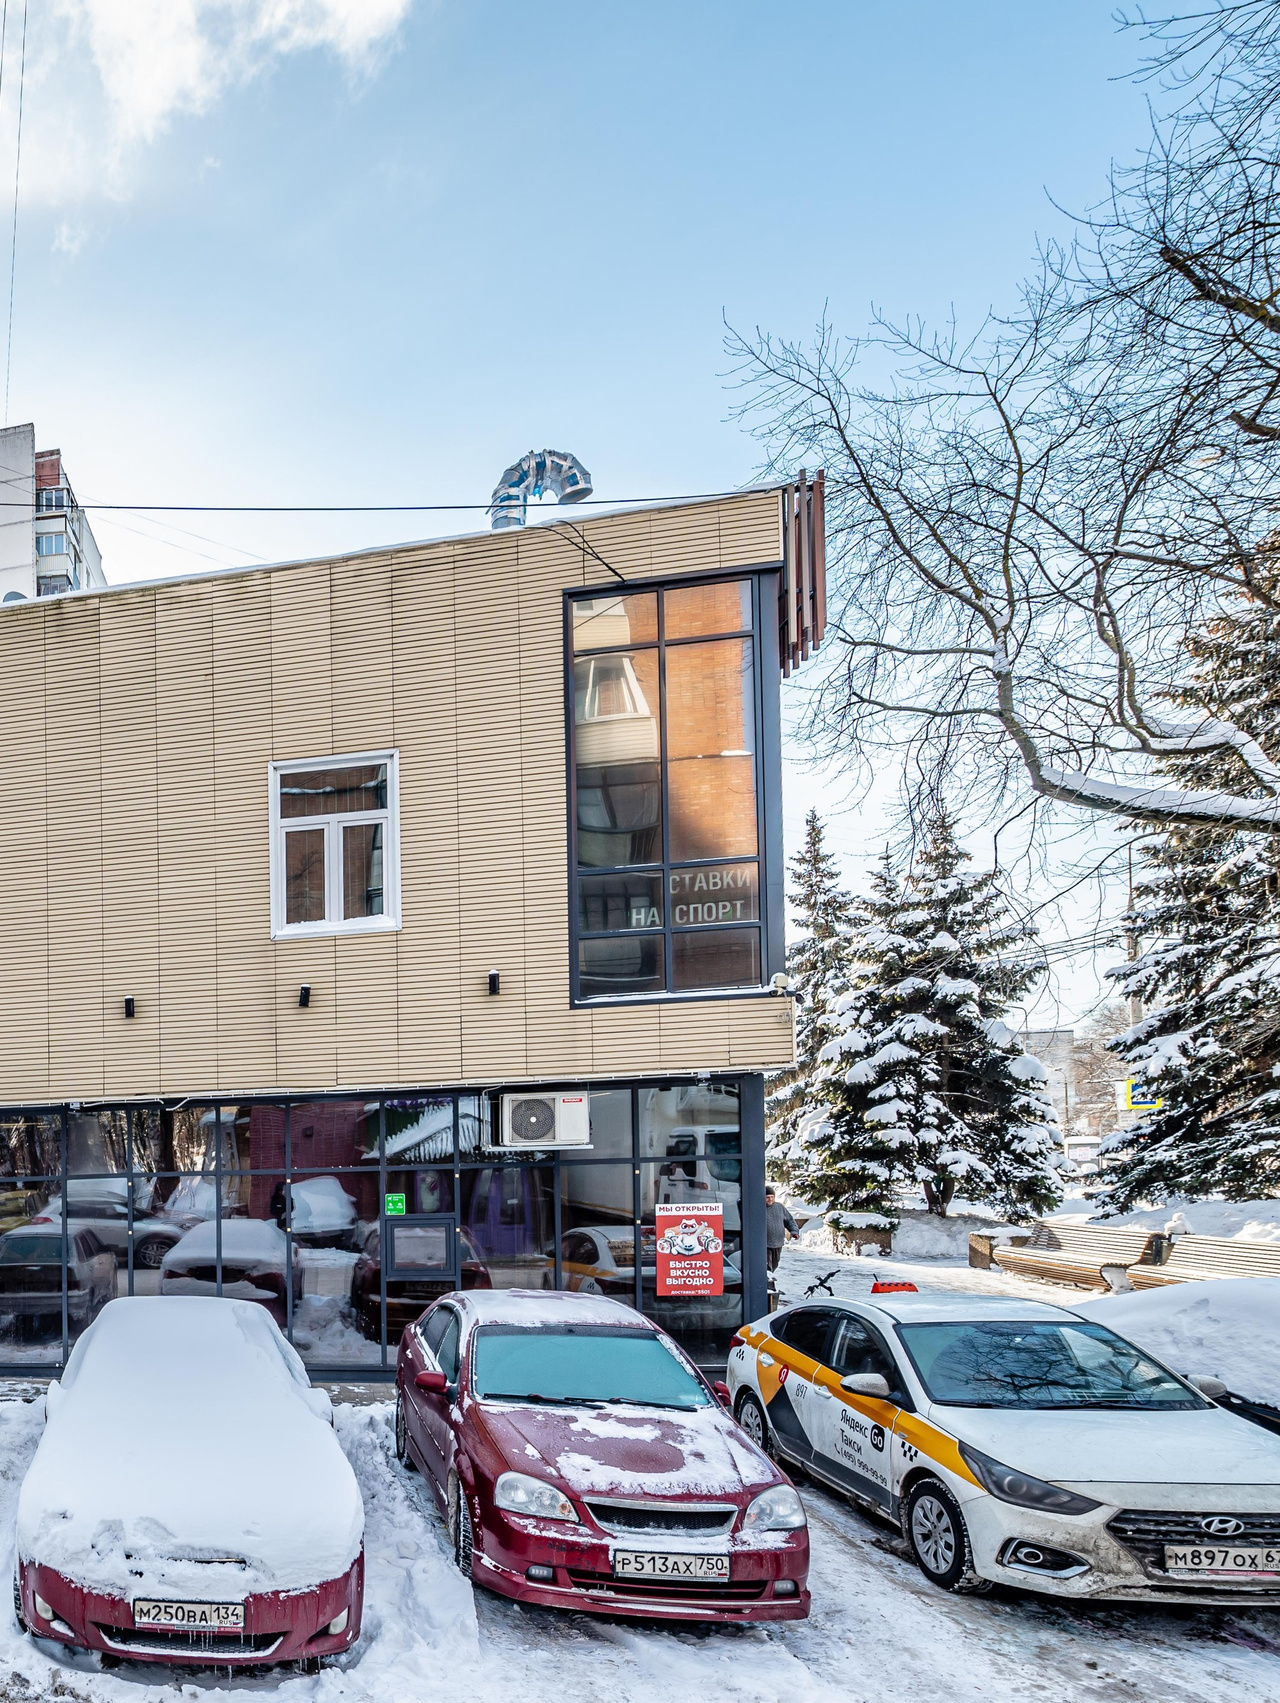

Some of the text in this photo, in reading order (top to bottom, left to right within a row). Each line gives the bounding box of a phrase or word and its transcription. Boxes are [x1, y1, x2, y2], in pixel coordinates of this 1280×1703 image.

[670, 869, 750, 894] СТАВКИ
[631, 900, 745, 927] НА СПОРТ
[666, 1278, 714, 1286] ВЫГОДНО
[670, 1269, 710, 1277] ВКУСНО
[795, 1383, 808, 1399] 897
[841, 1408, 869, 1439] Яндекс
[840, 1428, 862, 1456] Такси
[871, 1428, 883, 1448] Go
[697, 1557, 724, 1570] 750
[213, 1606, 240, 1620] 134
